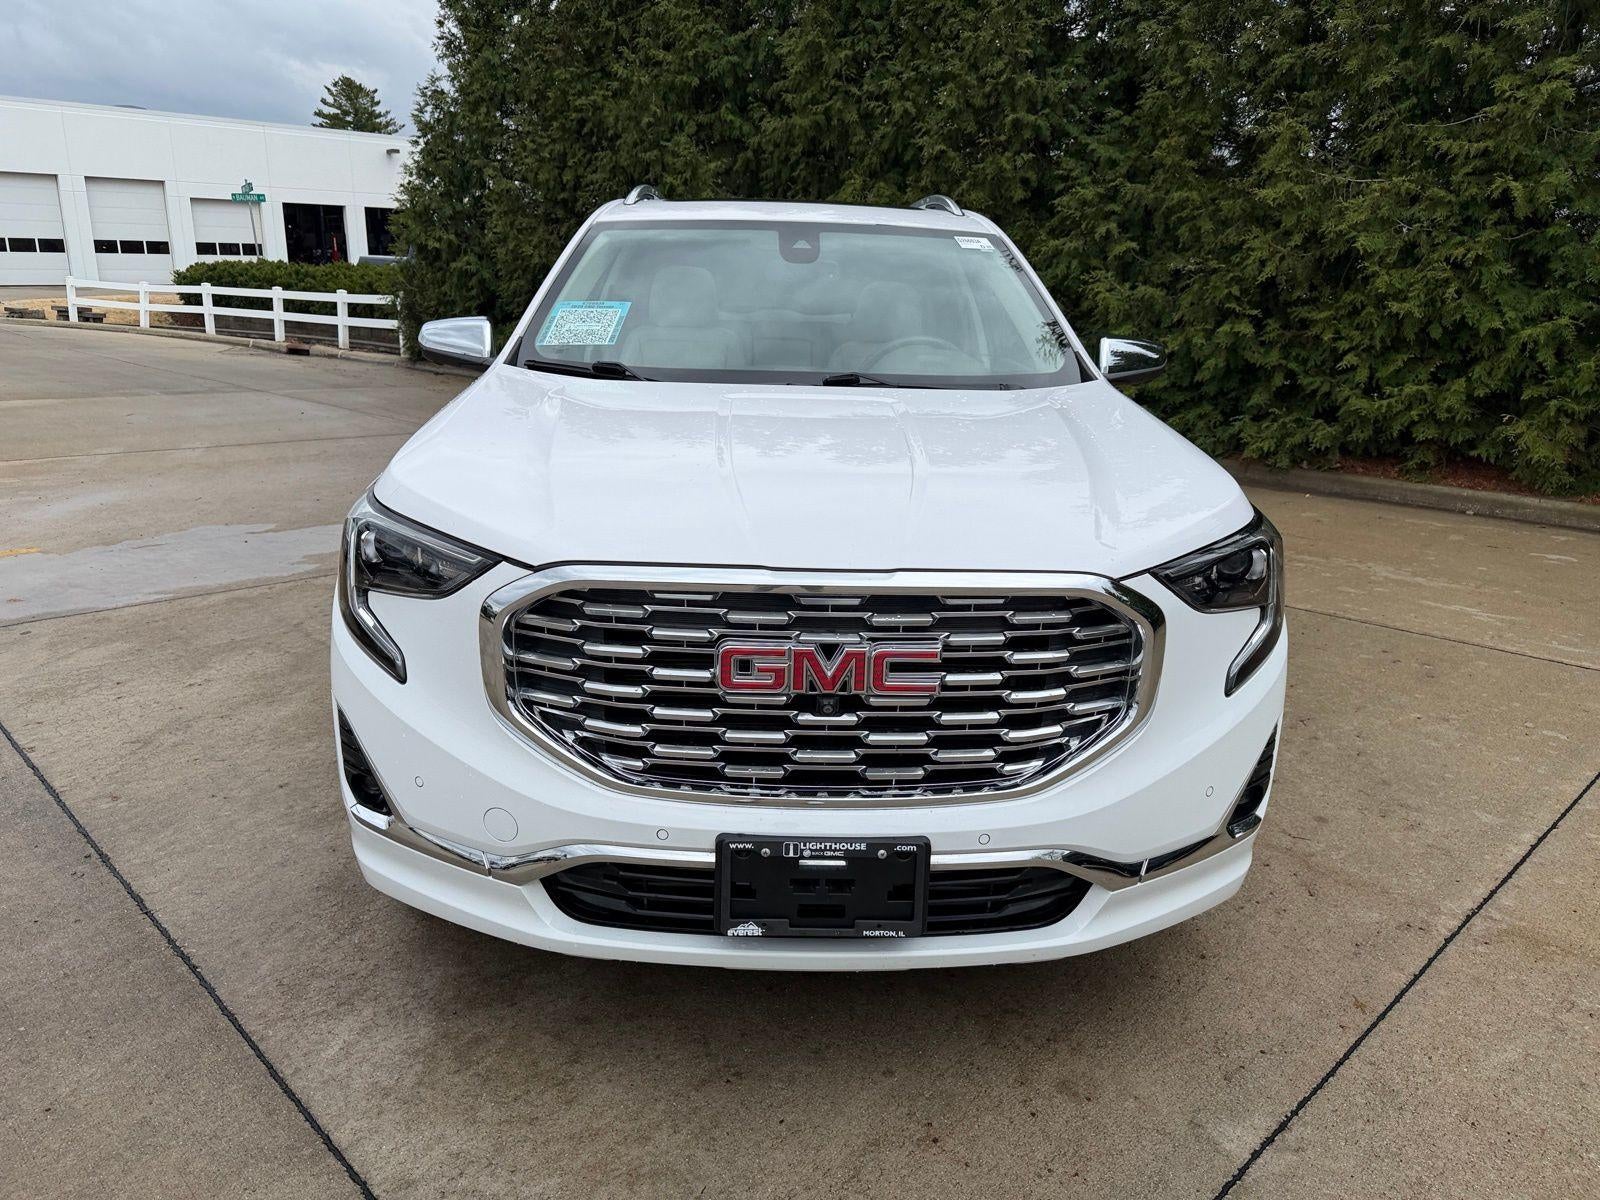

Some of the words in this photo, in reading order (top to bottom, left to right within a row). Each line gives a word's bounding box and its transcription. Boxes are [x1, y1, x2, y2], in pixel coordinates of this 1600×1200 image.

[715, 640, 943, 695] GMC
[800, 842, 867, 850] LIGHTHOUSE
[894, 844, 917, 852] .com
[727, 928, 762, 936] everest
[863, 930, 897, 938] MORTON,
